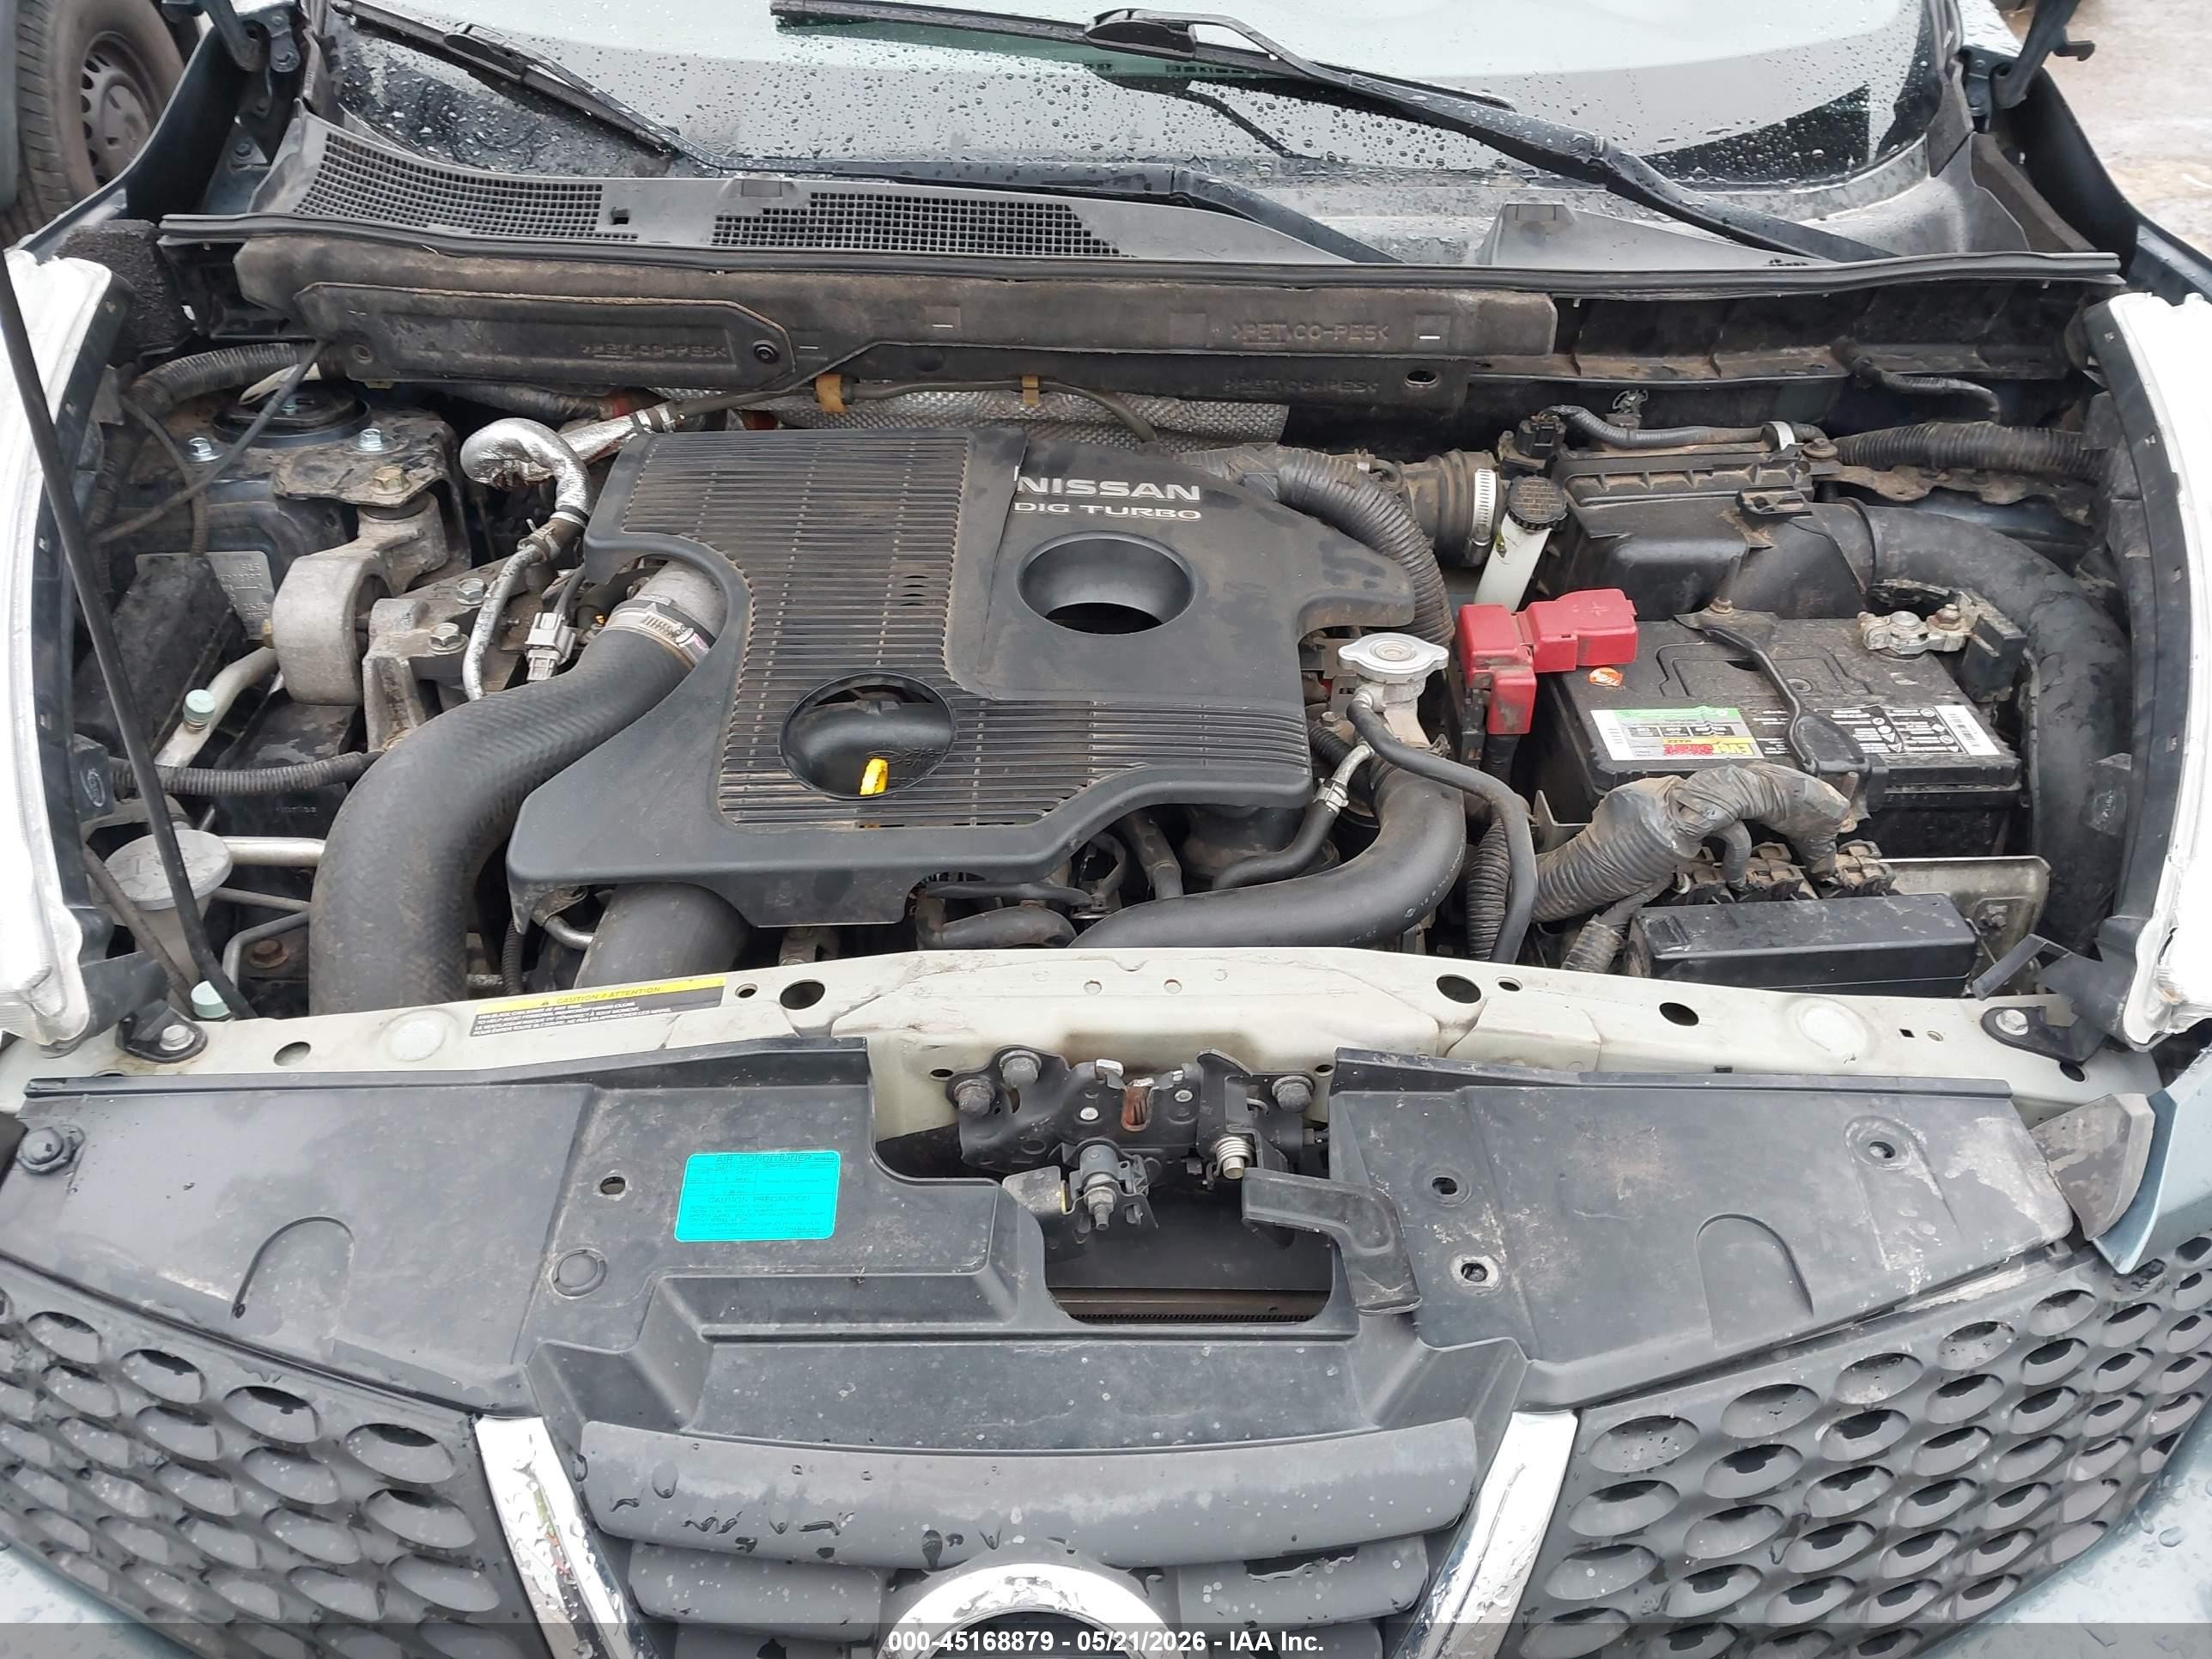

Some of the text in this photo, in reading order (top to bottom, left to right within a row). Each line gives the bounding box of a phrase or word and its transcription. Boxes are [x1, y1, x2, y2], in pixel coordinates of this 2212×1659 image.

[1017, 476, 1200, 501] NISSAN
[1013, 501, 1201, 520] DIG TURBO
[556, 994, 599, 1004] CAUTION
[609, 987, 660, 997] ATTENTION
[739, 1154, 811, 1163] CONDITIONER
